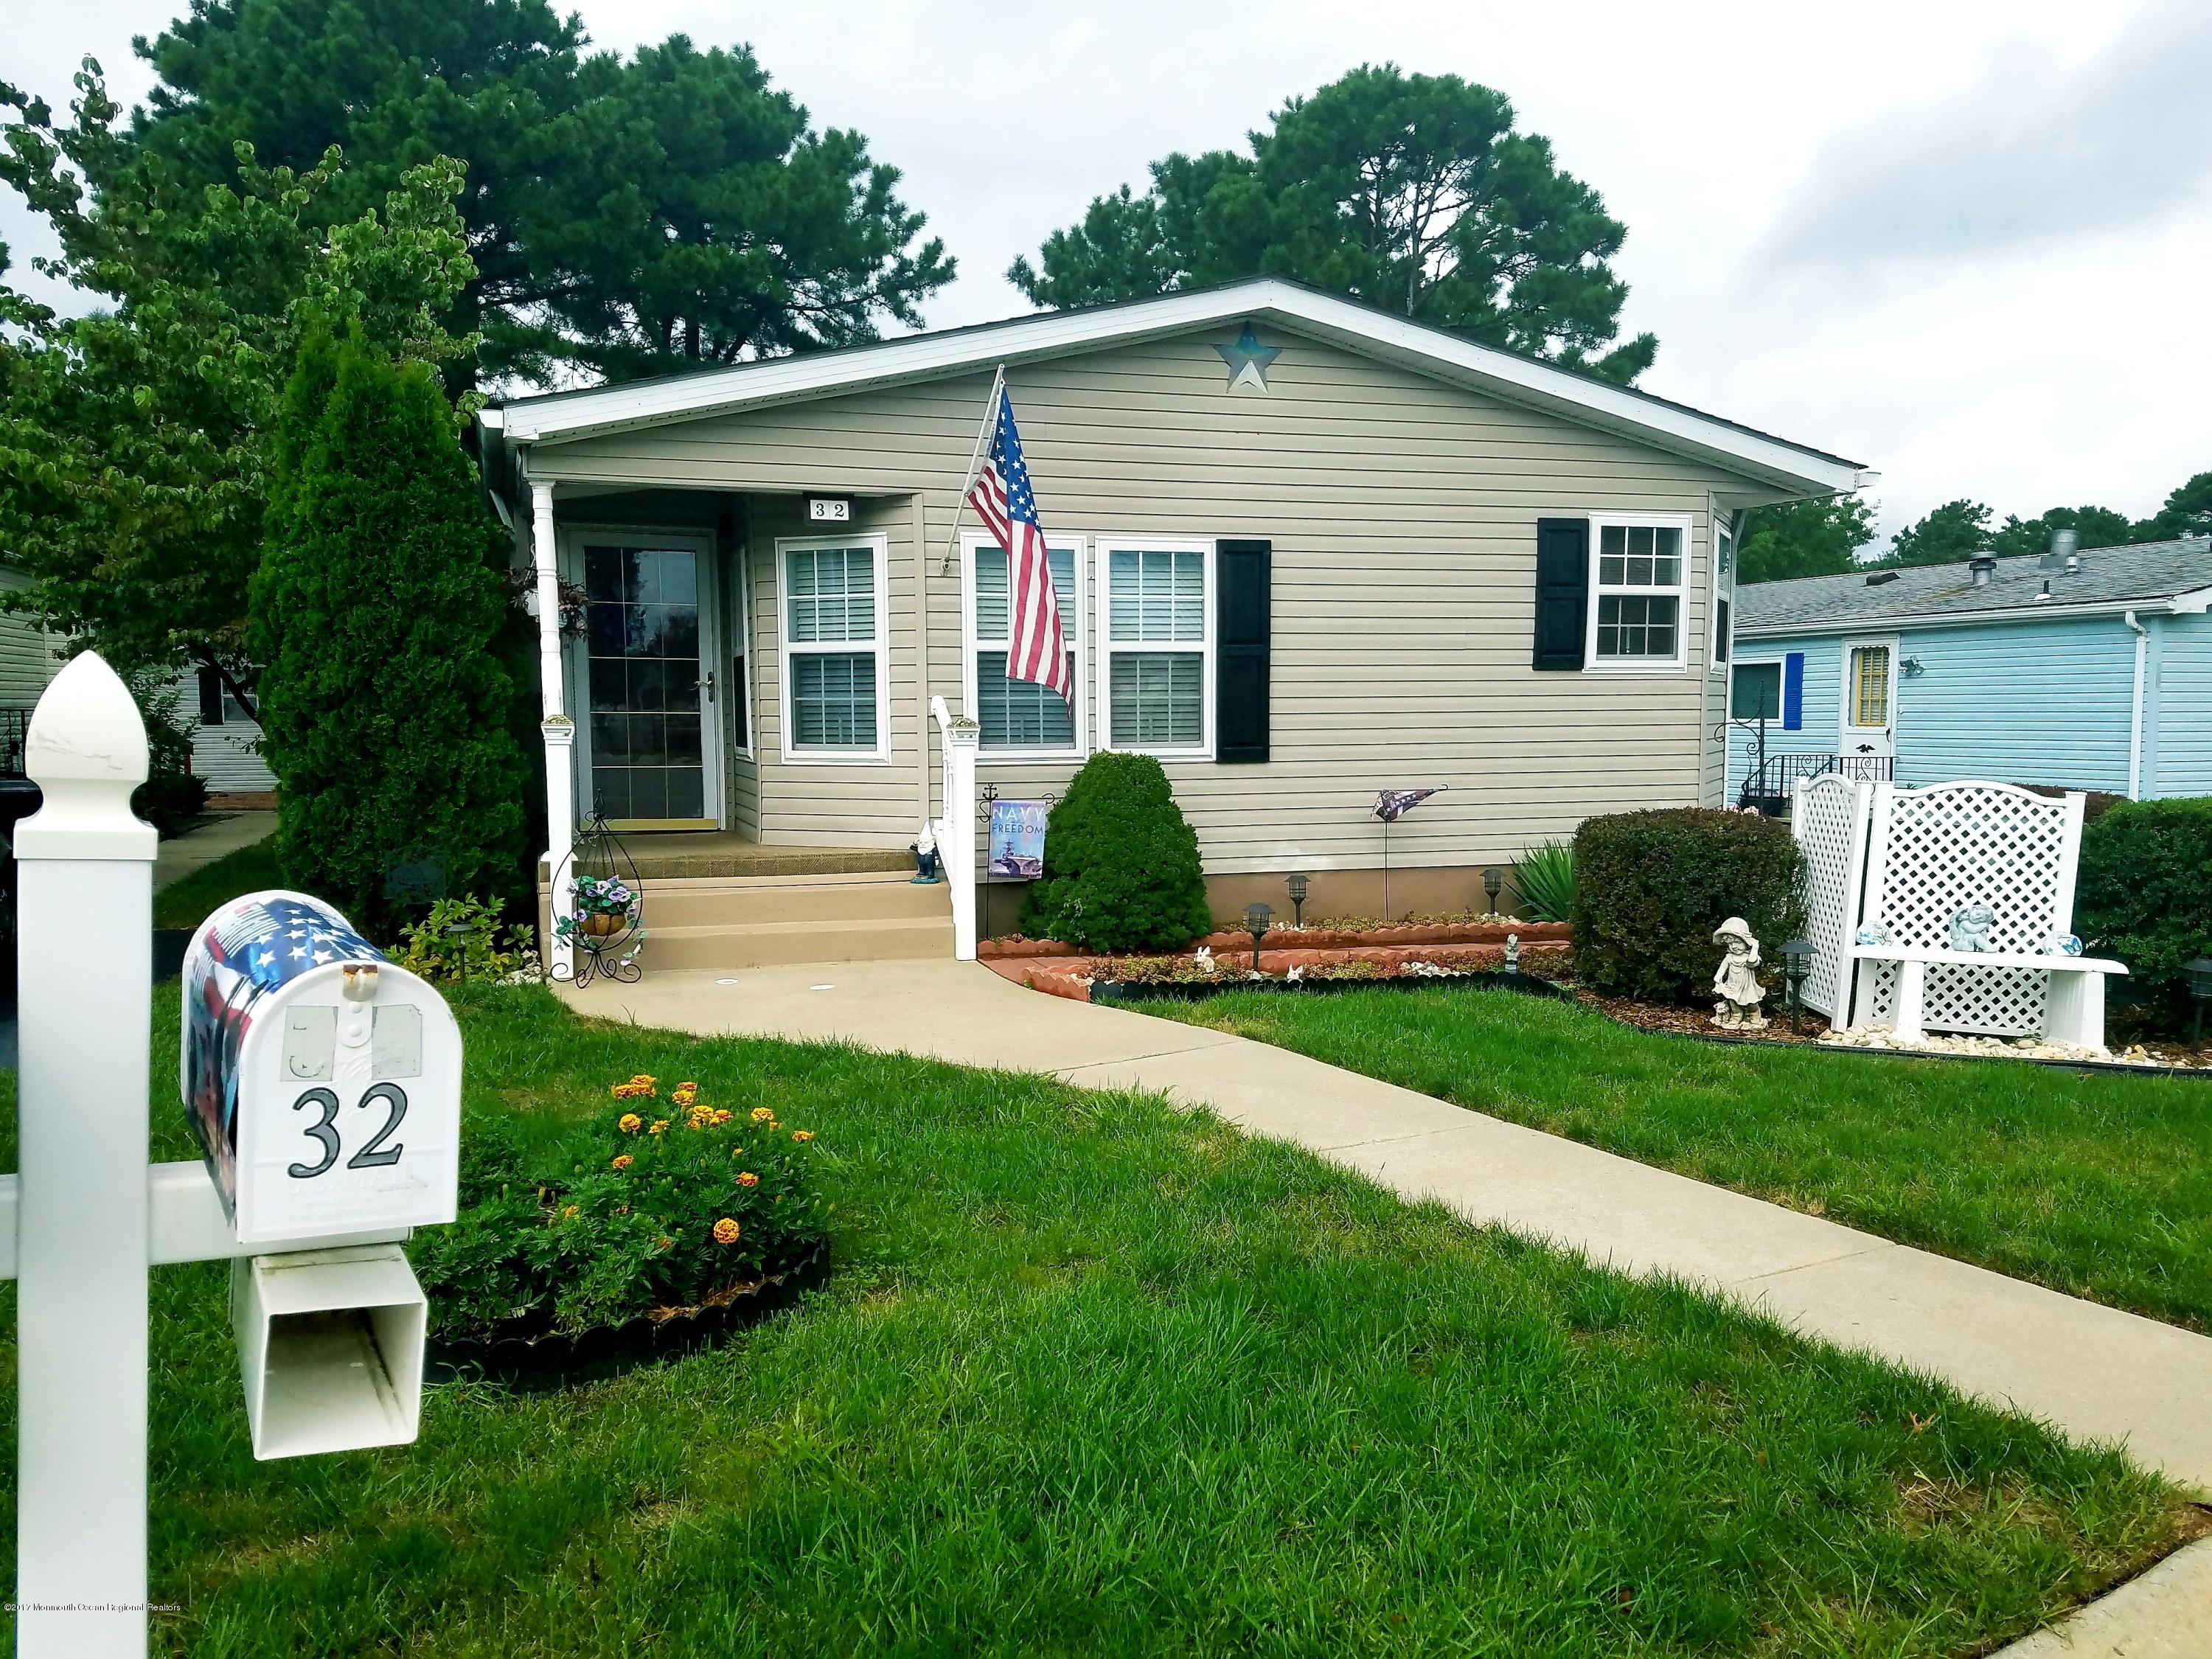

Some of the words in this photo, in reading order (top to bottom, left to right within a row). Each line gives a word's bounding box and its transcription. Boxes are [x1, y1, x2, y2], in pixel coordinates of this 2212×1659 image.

[816, 504, 844, 517] 32
[992, 806, 1044, 821] NAVY
[992, 824, 1043, 833] FREEDOM
[287, 1082, 408, 1180] 32
